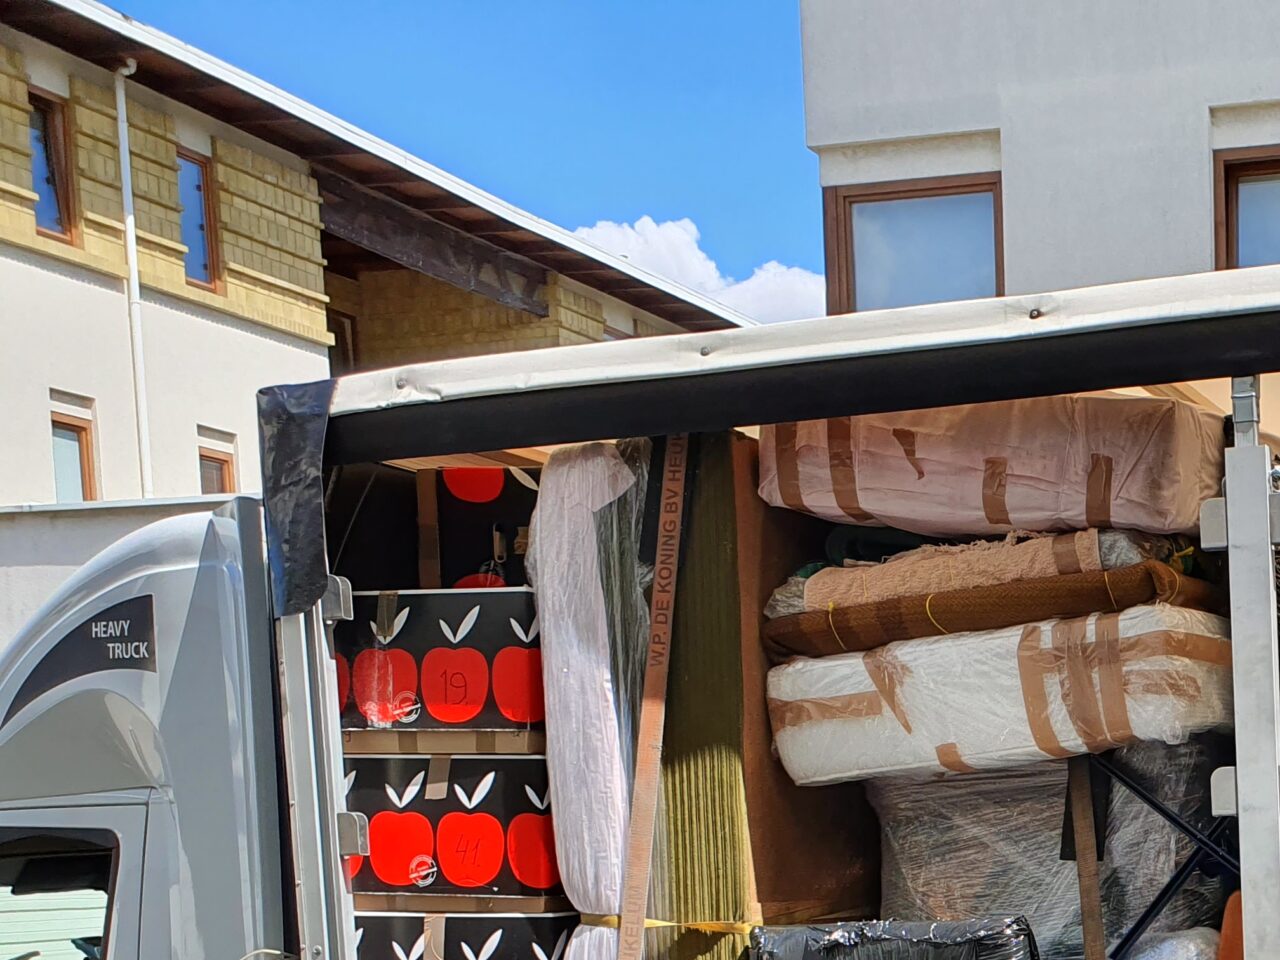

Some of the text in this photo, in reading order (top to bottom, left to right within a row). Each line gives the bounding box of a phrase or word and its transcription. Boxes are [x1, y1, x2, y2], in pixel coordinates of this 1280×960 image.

[664, 488, 680, 514] BV
[657, 520, 677, 594] KONING
[655, 600, 671, 625] DE
[91, 620, 131, 638] HEAVY
[107, 642, 149, 659] TRUCK
[649, 631, 667, 667] W.P.
